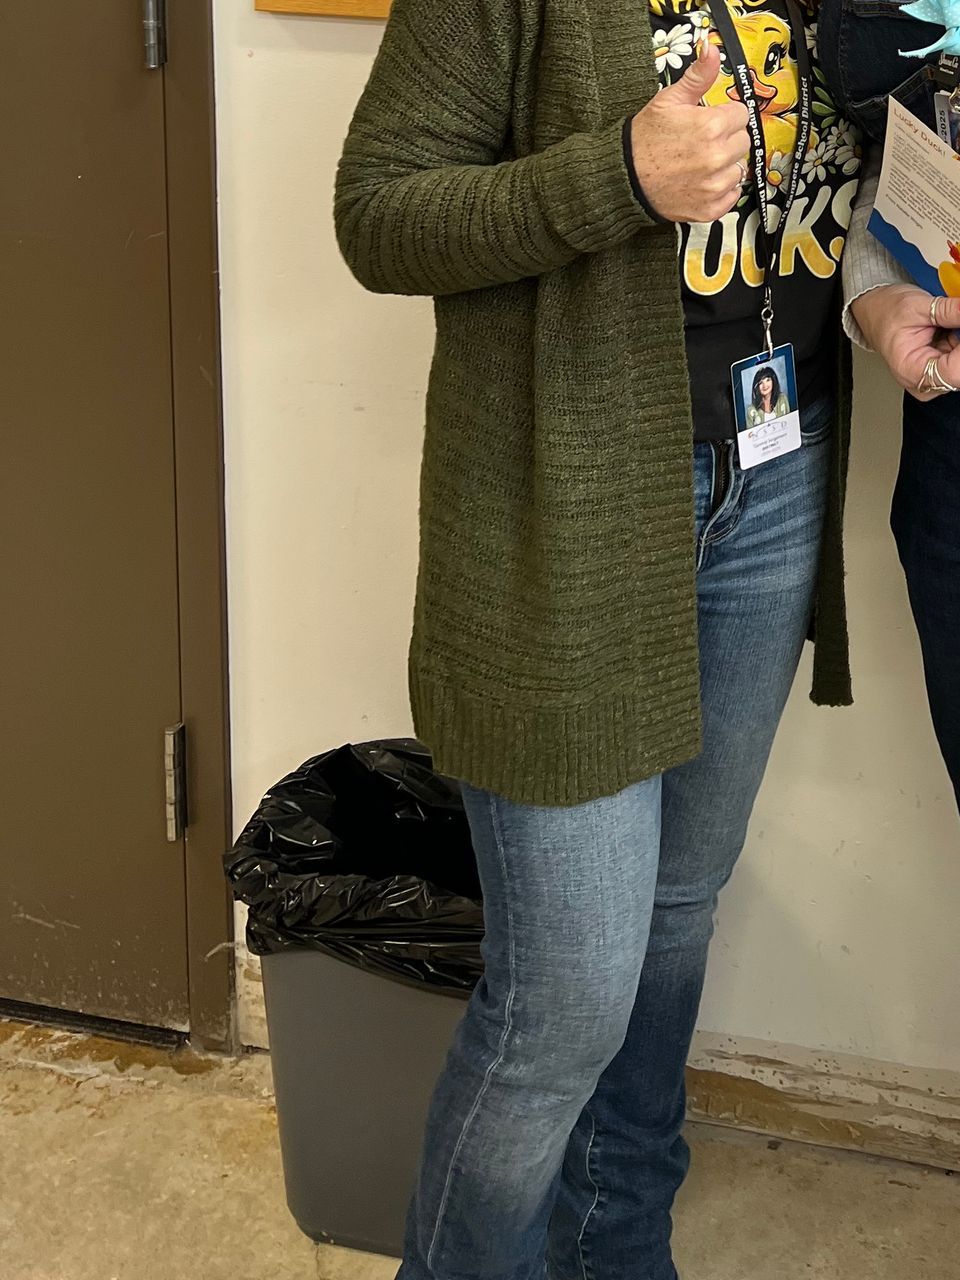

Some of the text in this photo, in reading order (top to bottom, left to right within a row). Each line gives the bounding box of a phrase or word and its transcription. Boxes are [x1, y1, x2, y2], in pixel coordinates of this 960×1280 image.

[736, 64, 751, 102] North
[745, 99, 761, 147] Sanpete
[755, 148, 765, 189] School
[786, 161, 800, 210] Sanpete
[795, 119, 809, 162] School
[893, 107, 946, 157] Lucky Duck!
[675, 179, 860, 297] UCKS
